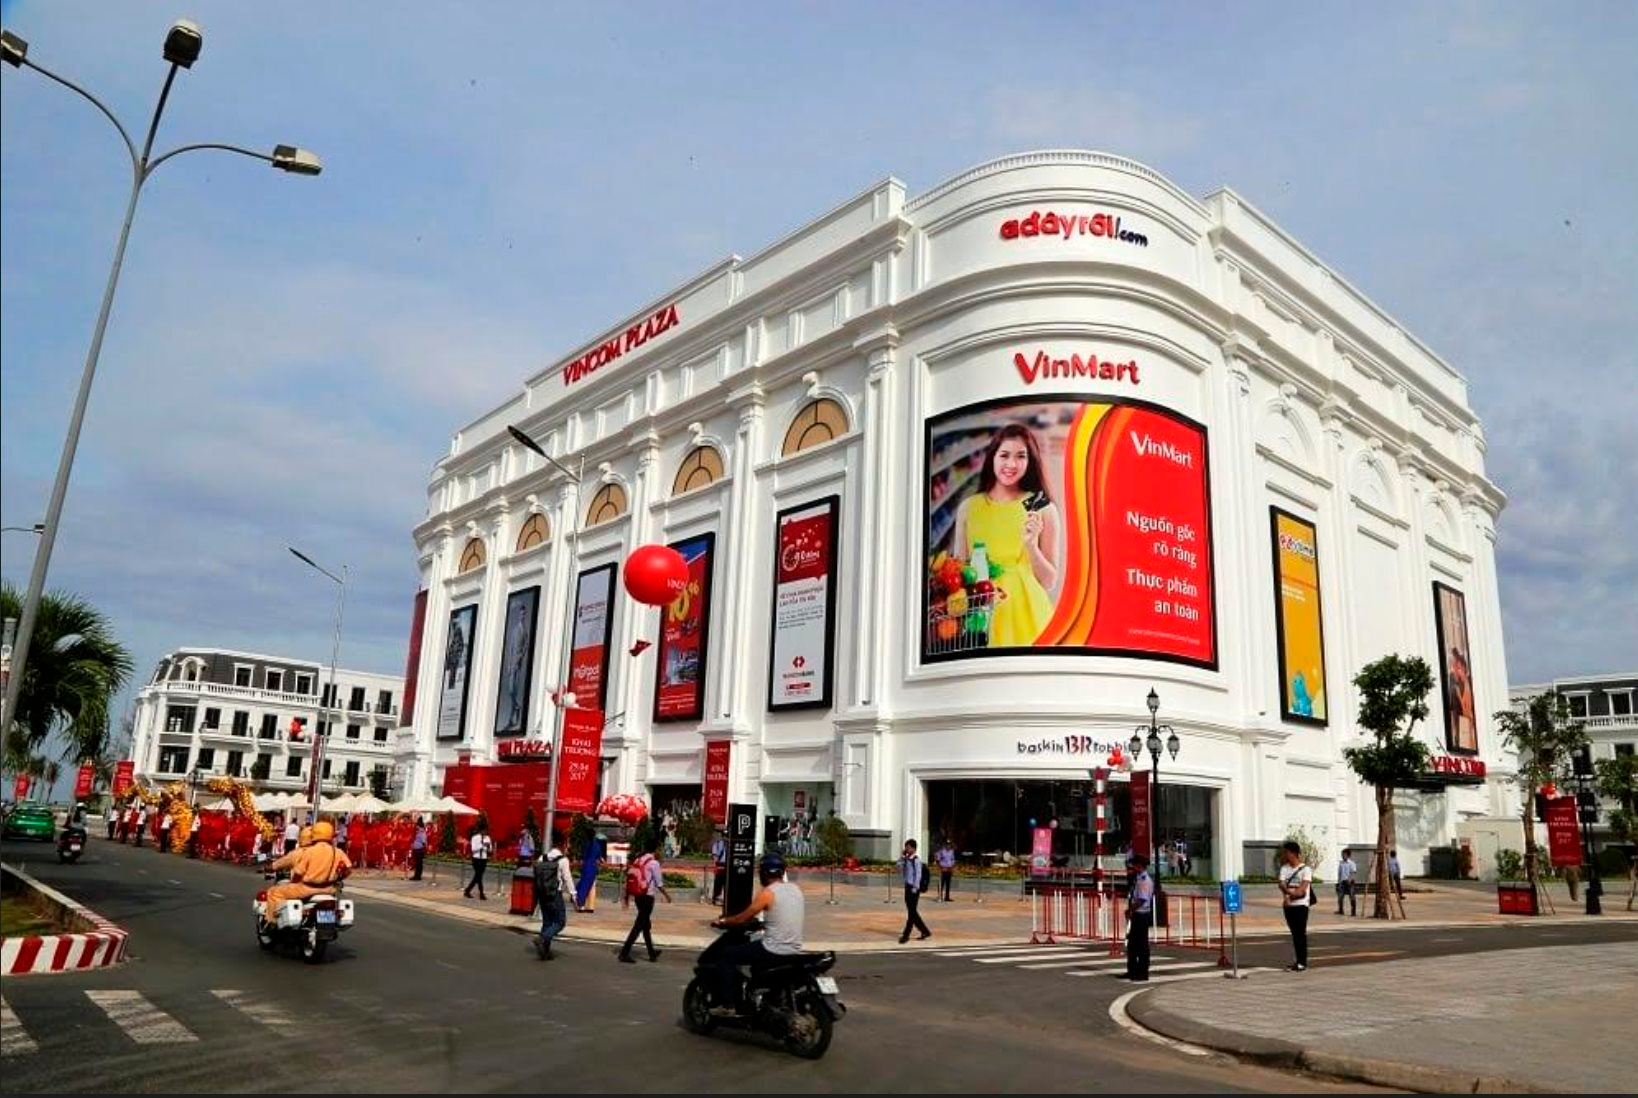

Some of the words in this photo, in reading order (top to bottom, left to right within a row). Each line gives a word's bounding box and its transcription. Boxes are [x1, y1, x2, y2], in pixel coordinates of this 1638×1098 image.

[563, 337, 622, 386] VINCOM
[625, 304, 679, 352] PLAZA
[1014, 350, 1141, 385] VinMart
[1130, 430, 1193, 469] VinMart
[1154, 600, 1171, 615] an
[1018, 739, 1063, 754] baskin
[1065, 735, 1093, 755] BR
[738, 813, 751, 835] P
